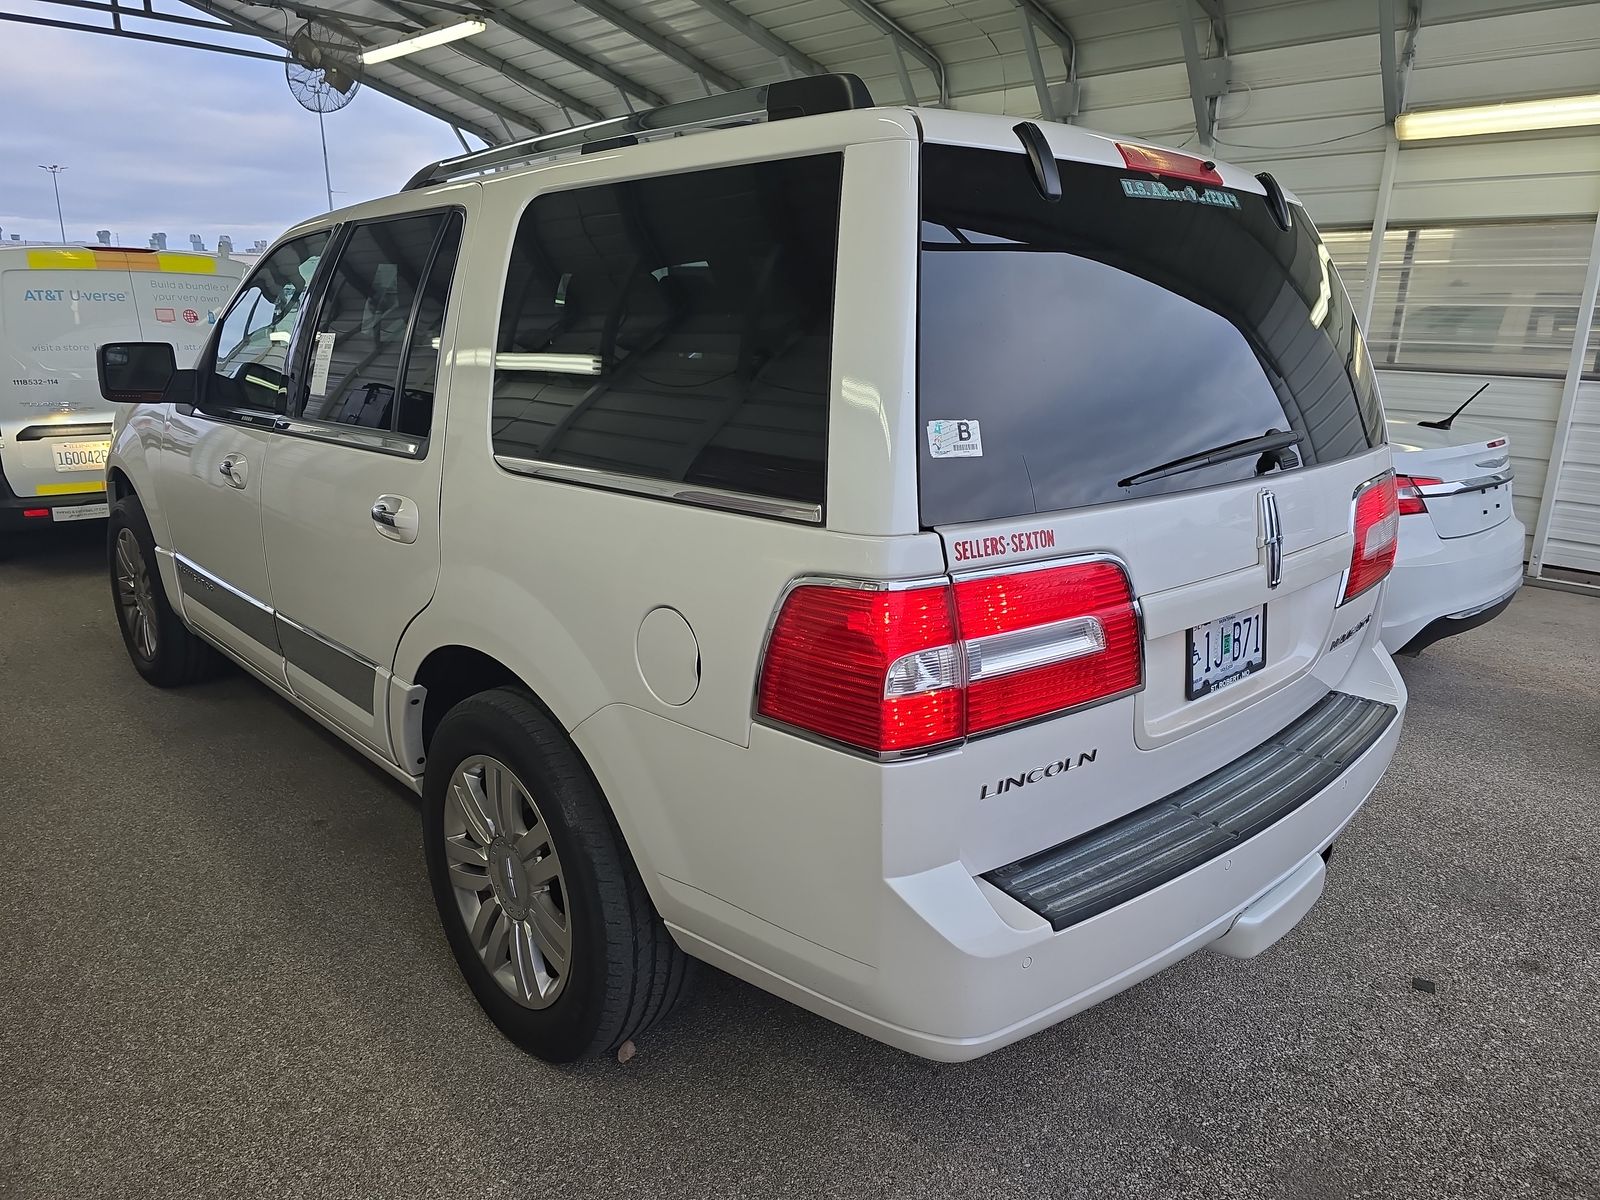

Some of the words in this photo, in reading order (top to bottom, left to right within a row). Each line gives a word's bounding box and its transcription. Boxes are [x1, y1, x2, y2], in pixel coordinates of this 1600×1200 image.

[150, 280, 176, 289] Build
[185, 282, 218, 291] bundle
[220, 284, 229, 292] of
[24, 289, 64, 301] AT&T
[153, 294, 175, 302] your
[178, 295, 197, 303] very
[32, 344, 55, 352] visit
[63, 344, 89, 352] store
[12, 378, 59, 386] 1118532-114
[957, 421, 972, 441] B
[980, 748, 1097, 800] LINCOLN
